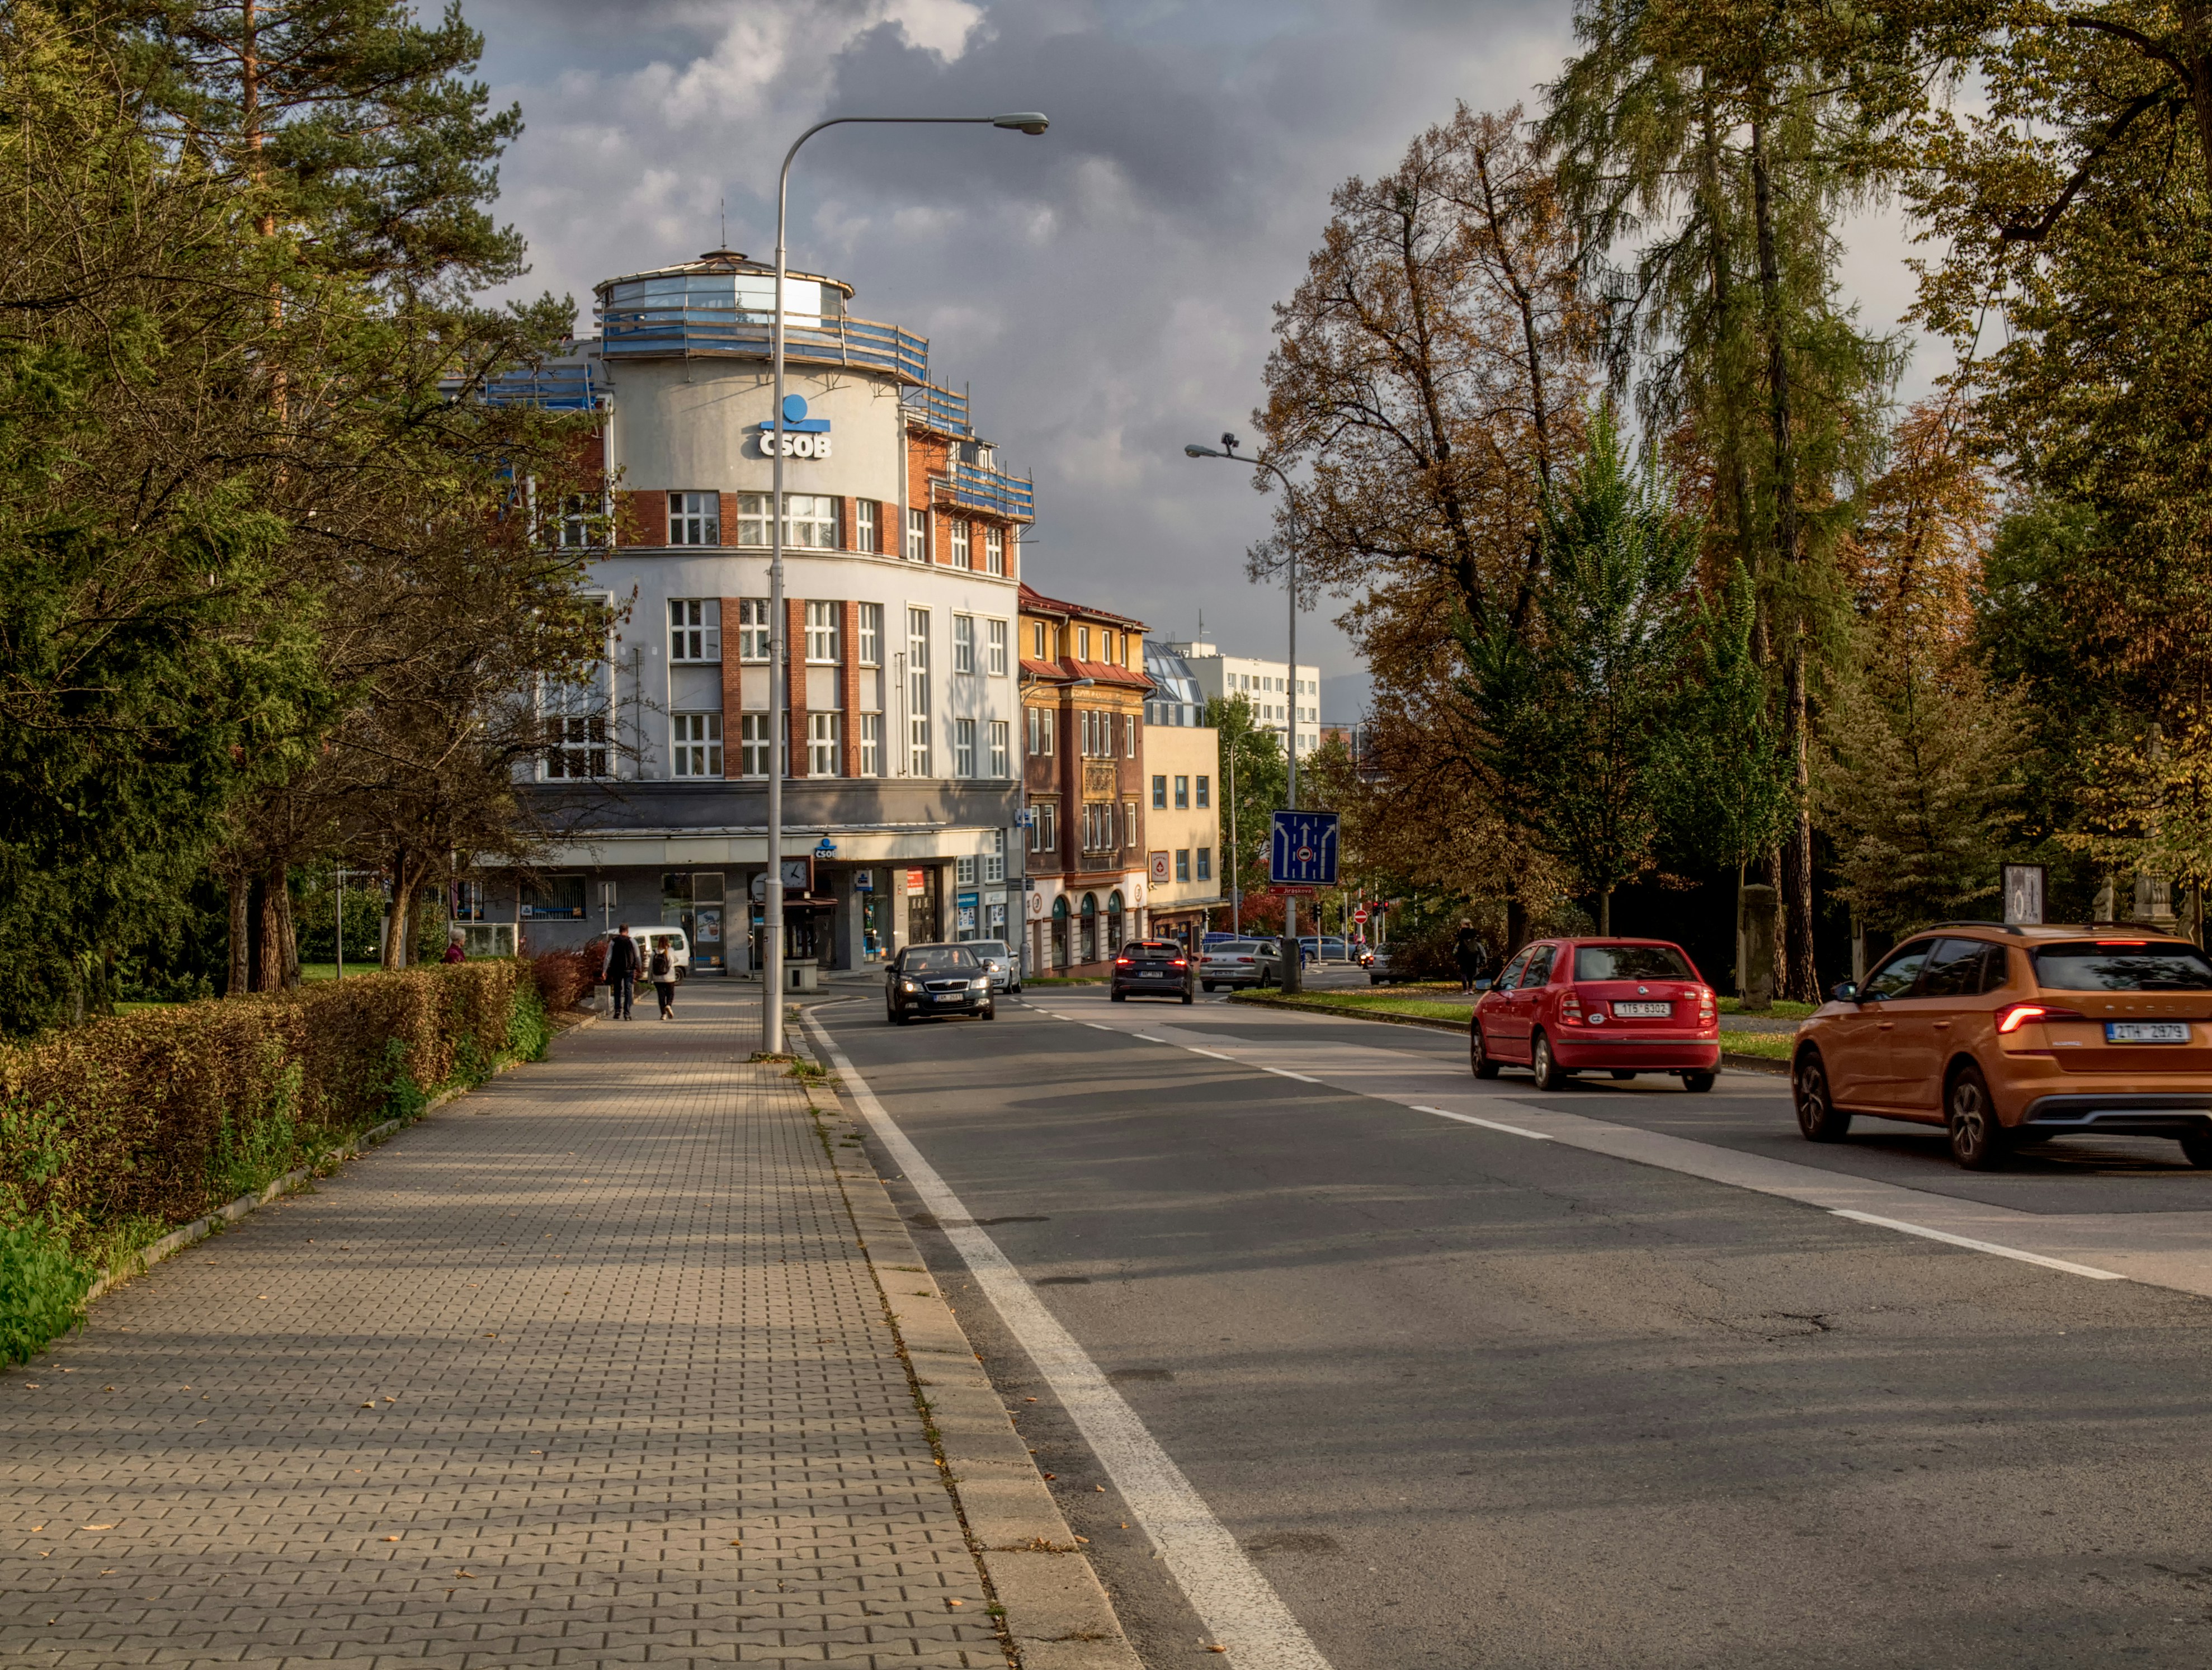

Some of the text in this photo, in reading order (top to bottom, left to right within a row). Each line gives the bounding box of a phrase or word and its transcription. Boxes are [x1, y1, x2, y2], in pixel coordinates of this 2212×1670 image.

[760, 430, 832, 459] ČSOB
[1622, 1003, 1666, 1013] 1T5 6302
